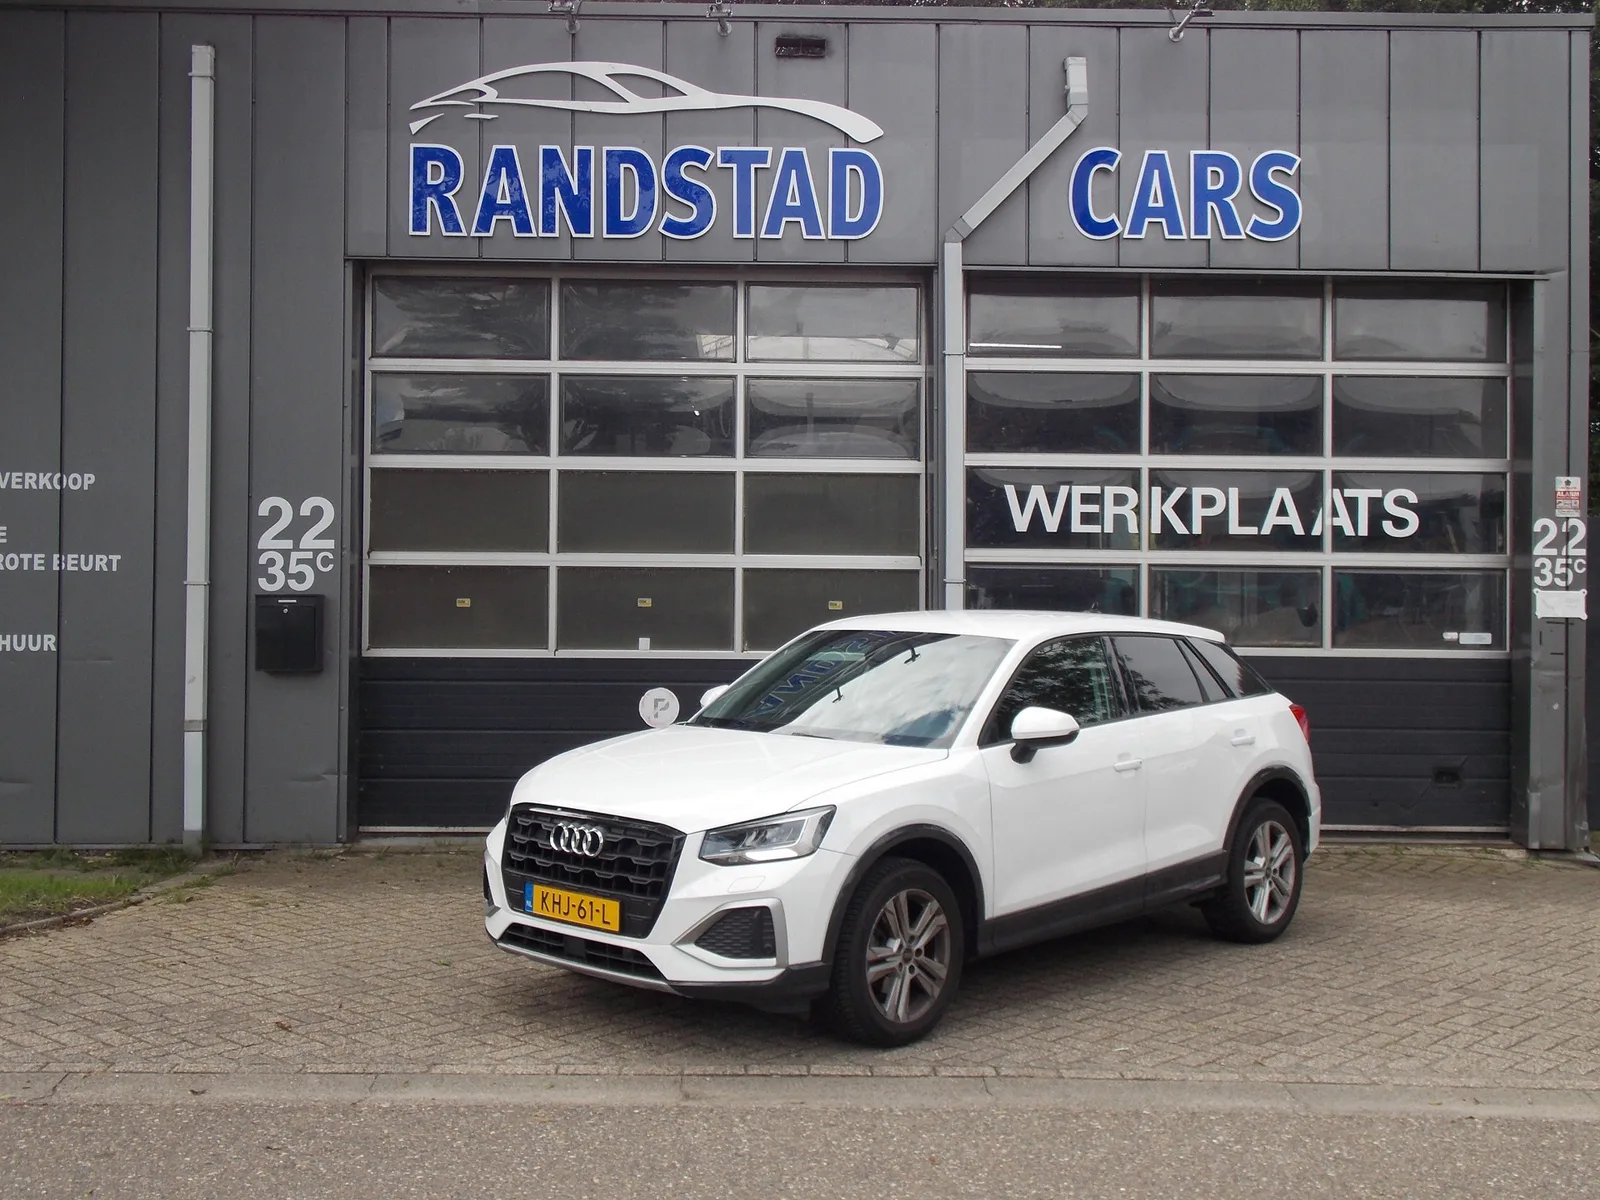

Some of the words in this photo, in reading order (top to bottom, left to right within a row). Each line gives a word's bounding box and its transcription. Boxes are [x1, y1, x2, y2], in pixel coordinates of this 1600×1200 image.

[408, 143, 885, 239] RANDSTAD
[1068, 146, 1303, 242] CARS
[257, 496, 335, 549] 22
[1003, 484, 1420, 538] WERKPLAATS
[1532, 517, 1587, 556] 22
[52, 553, 122, 572] BEURT
[0, 634, 57, 651] HUUR
[653, 698, 670, 719] P
[541, 890, 611, 925] KHJ-61-L
